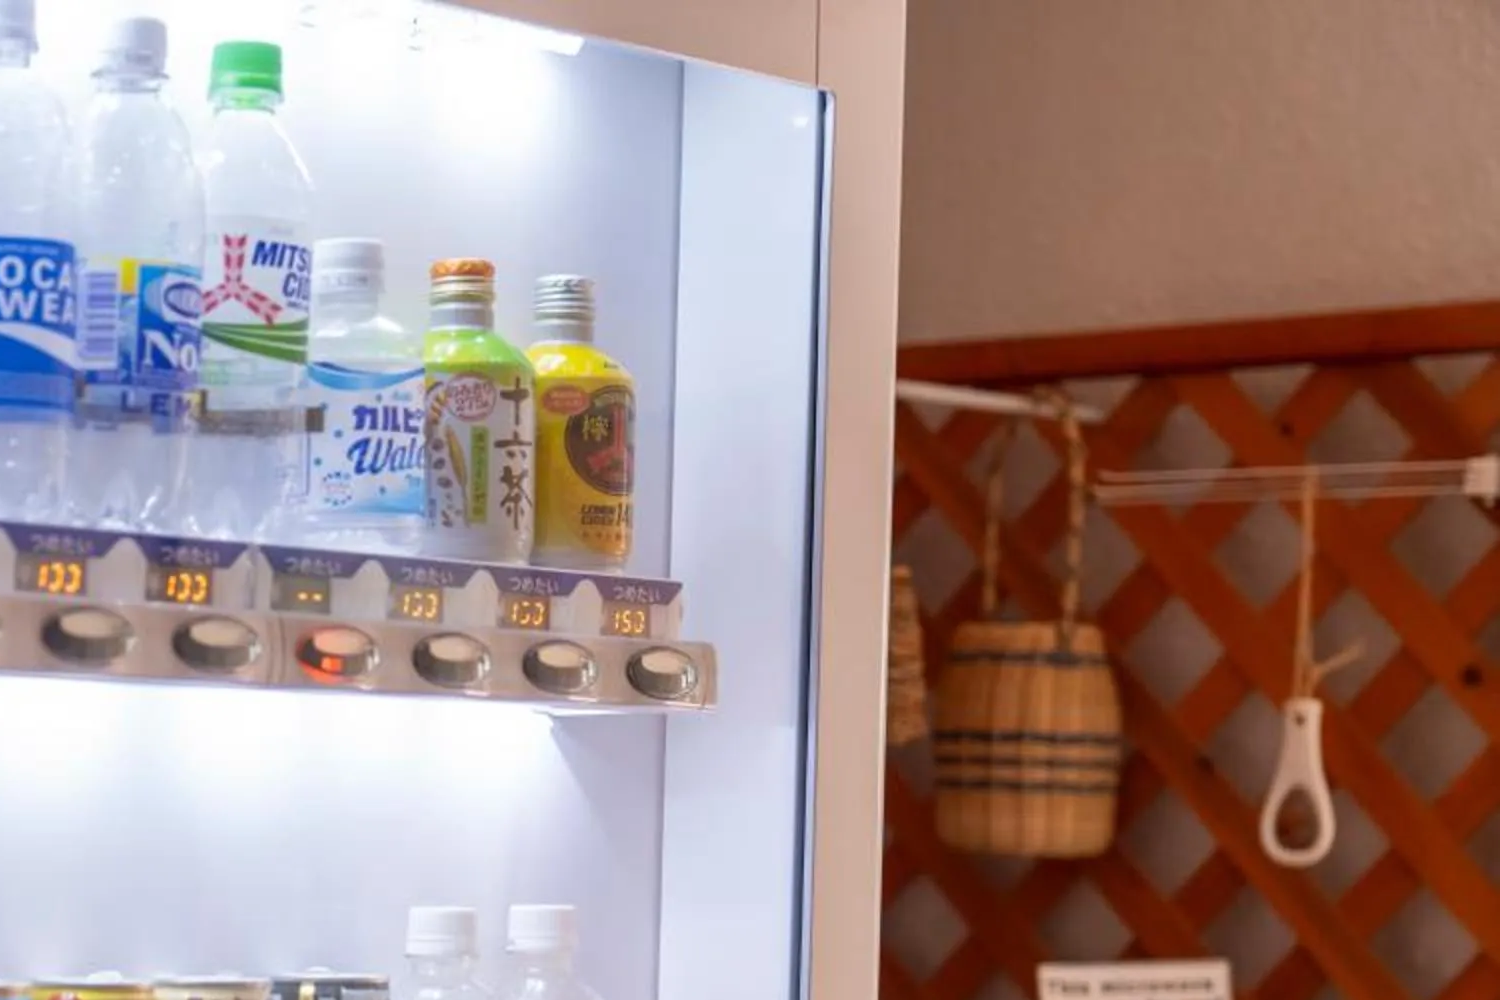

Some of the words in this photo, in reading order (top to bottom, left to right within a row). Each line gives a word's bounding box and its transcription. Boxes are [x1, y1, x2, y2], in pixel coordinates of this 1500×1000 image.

[252, 240, 310, 273] MITS
[353, 405, 425, 434] カルピ
[494, 376, 534, 531] 十六茶
[508, 575, 559, 595] つめたい
[615, 610, 644, 634] 150
